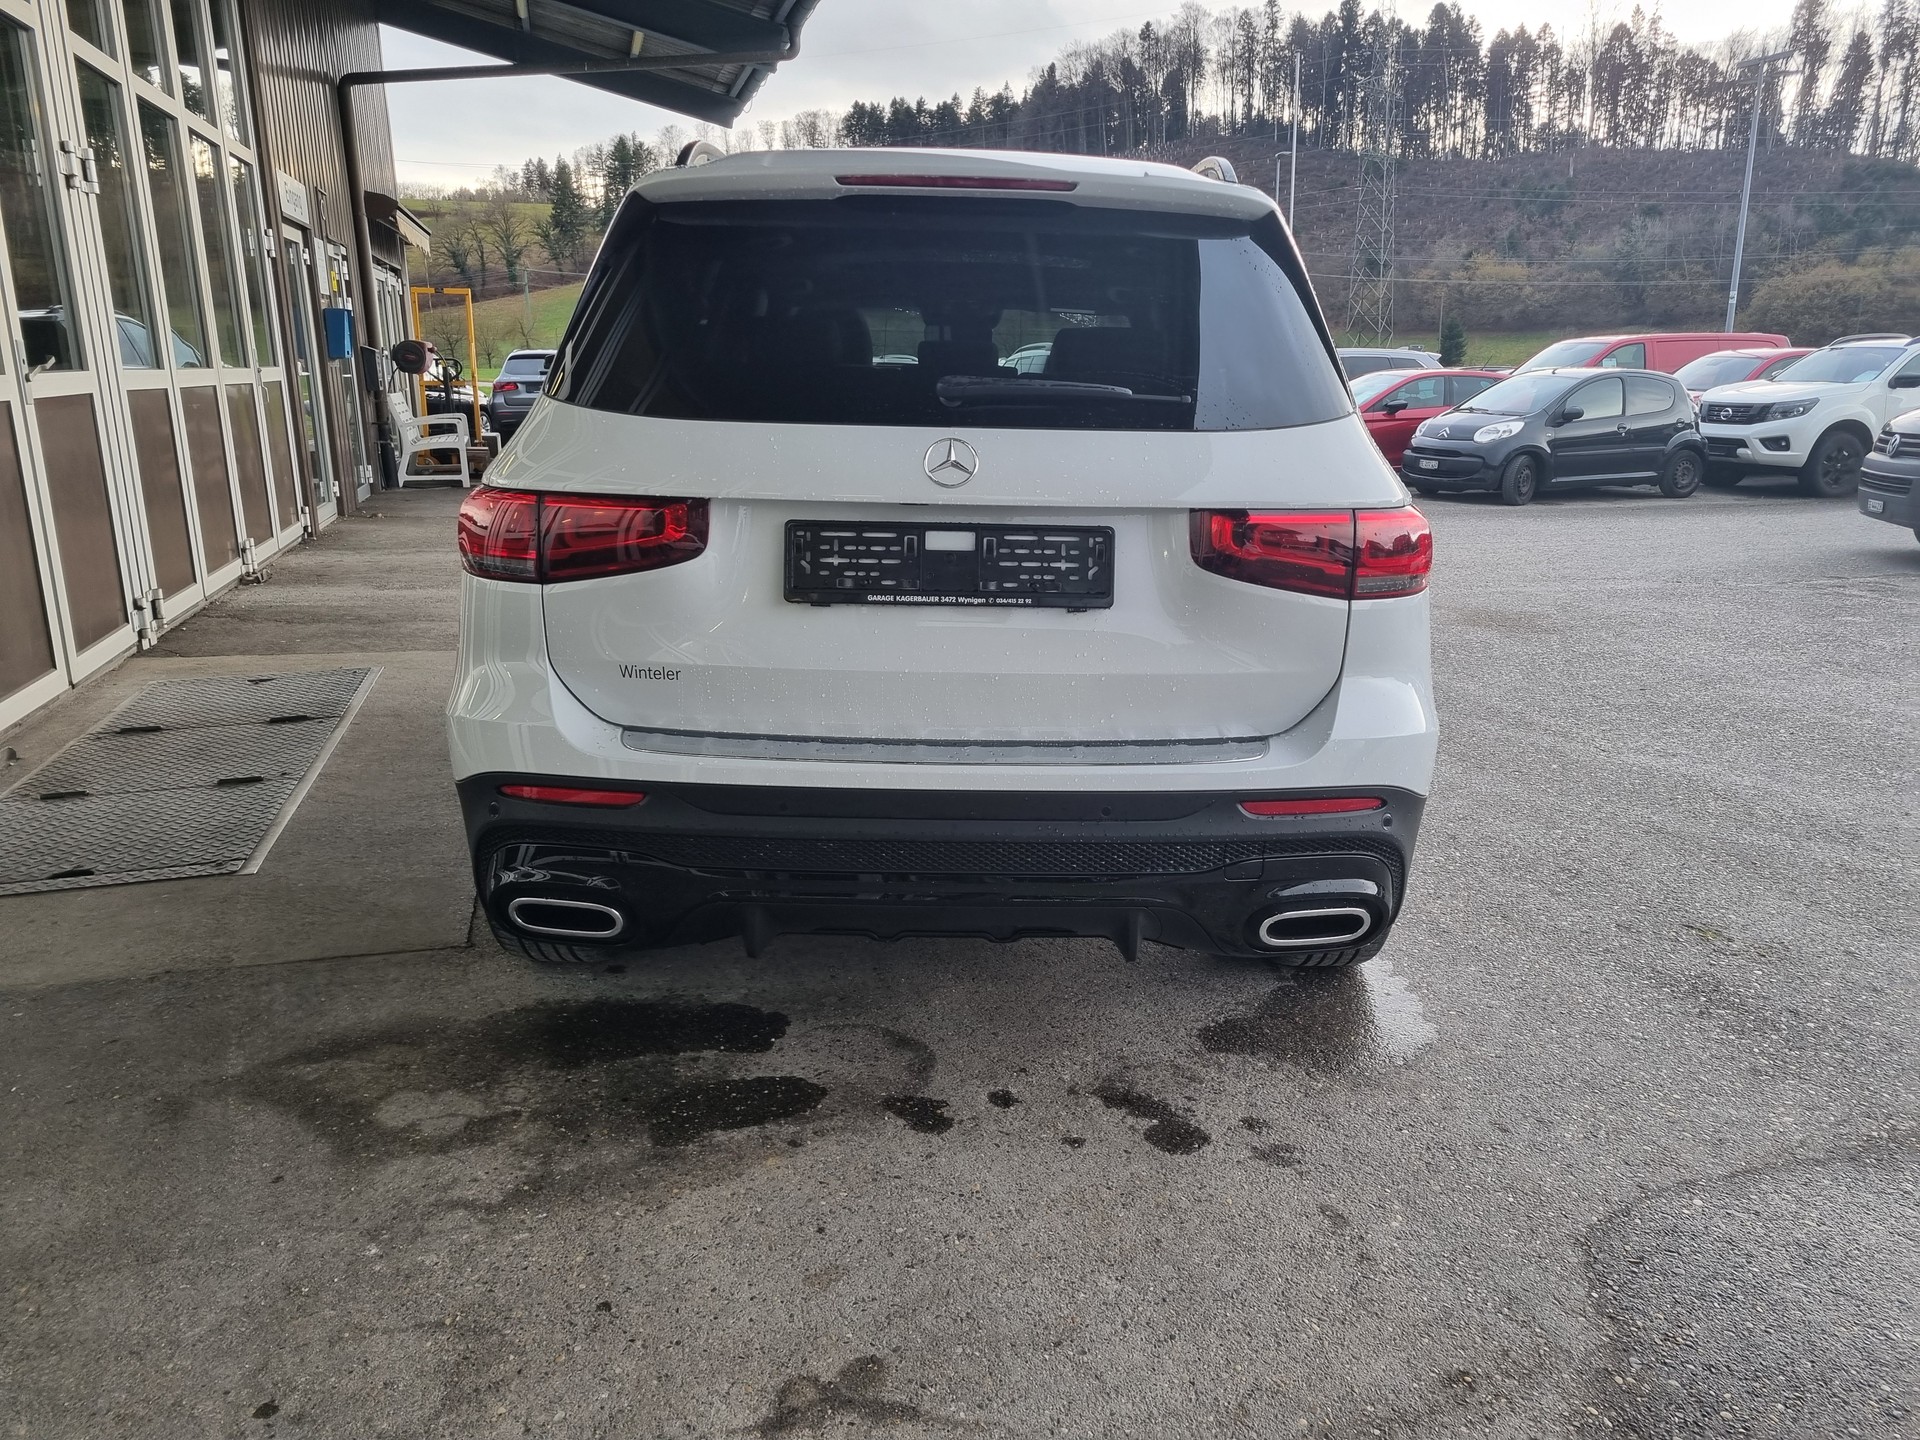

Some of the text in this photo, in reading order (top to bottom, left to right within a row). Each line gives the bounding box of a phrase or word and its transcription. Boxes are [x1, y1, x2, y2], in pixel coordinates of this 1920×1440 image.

[867, 594, 895, 602] GARAGE
[896, 595, 940, 603] KAGERBAUER
[957, 596, 986, 605] Wynigen
[618, 664, 682, 681] Winteler
